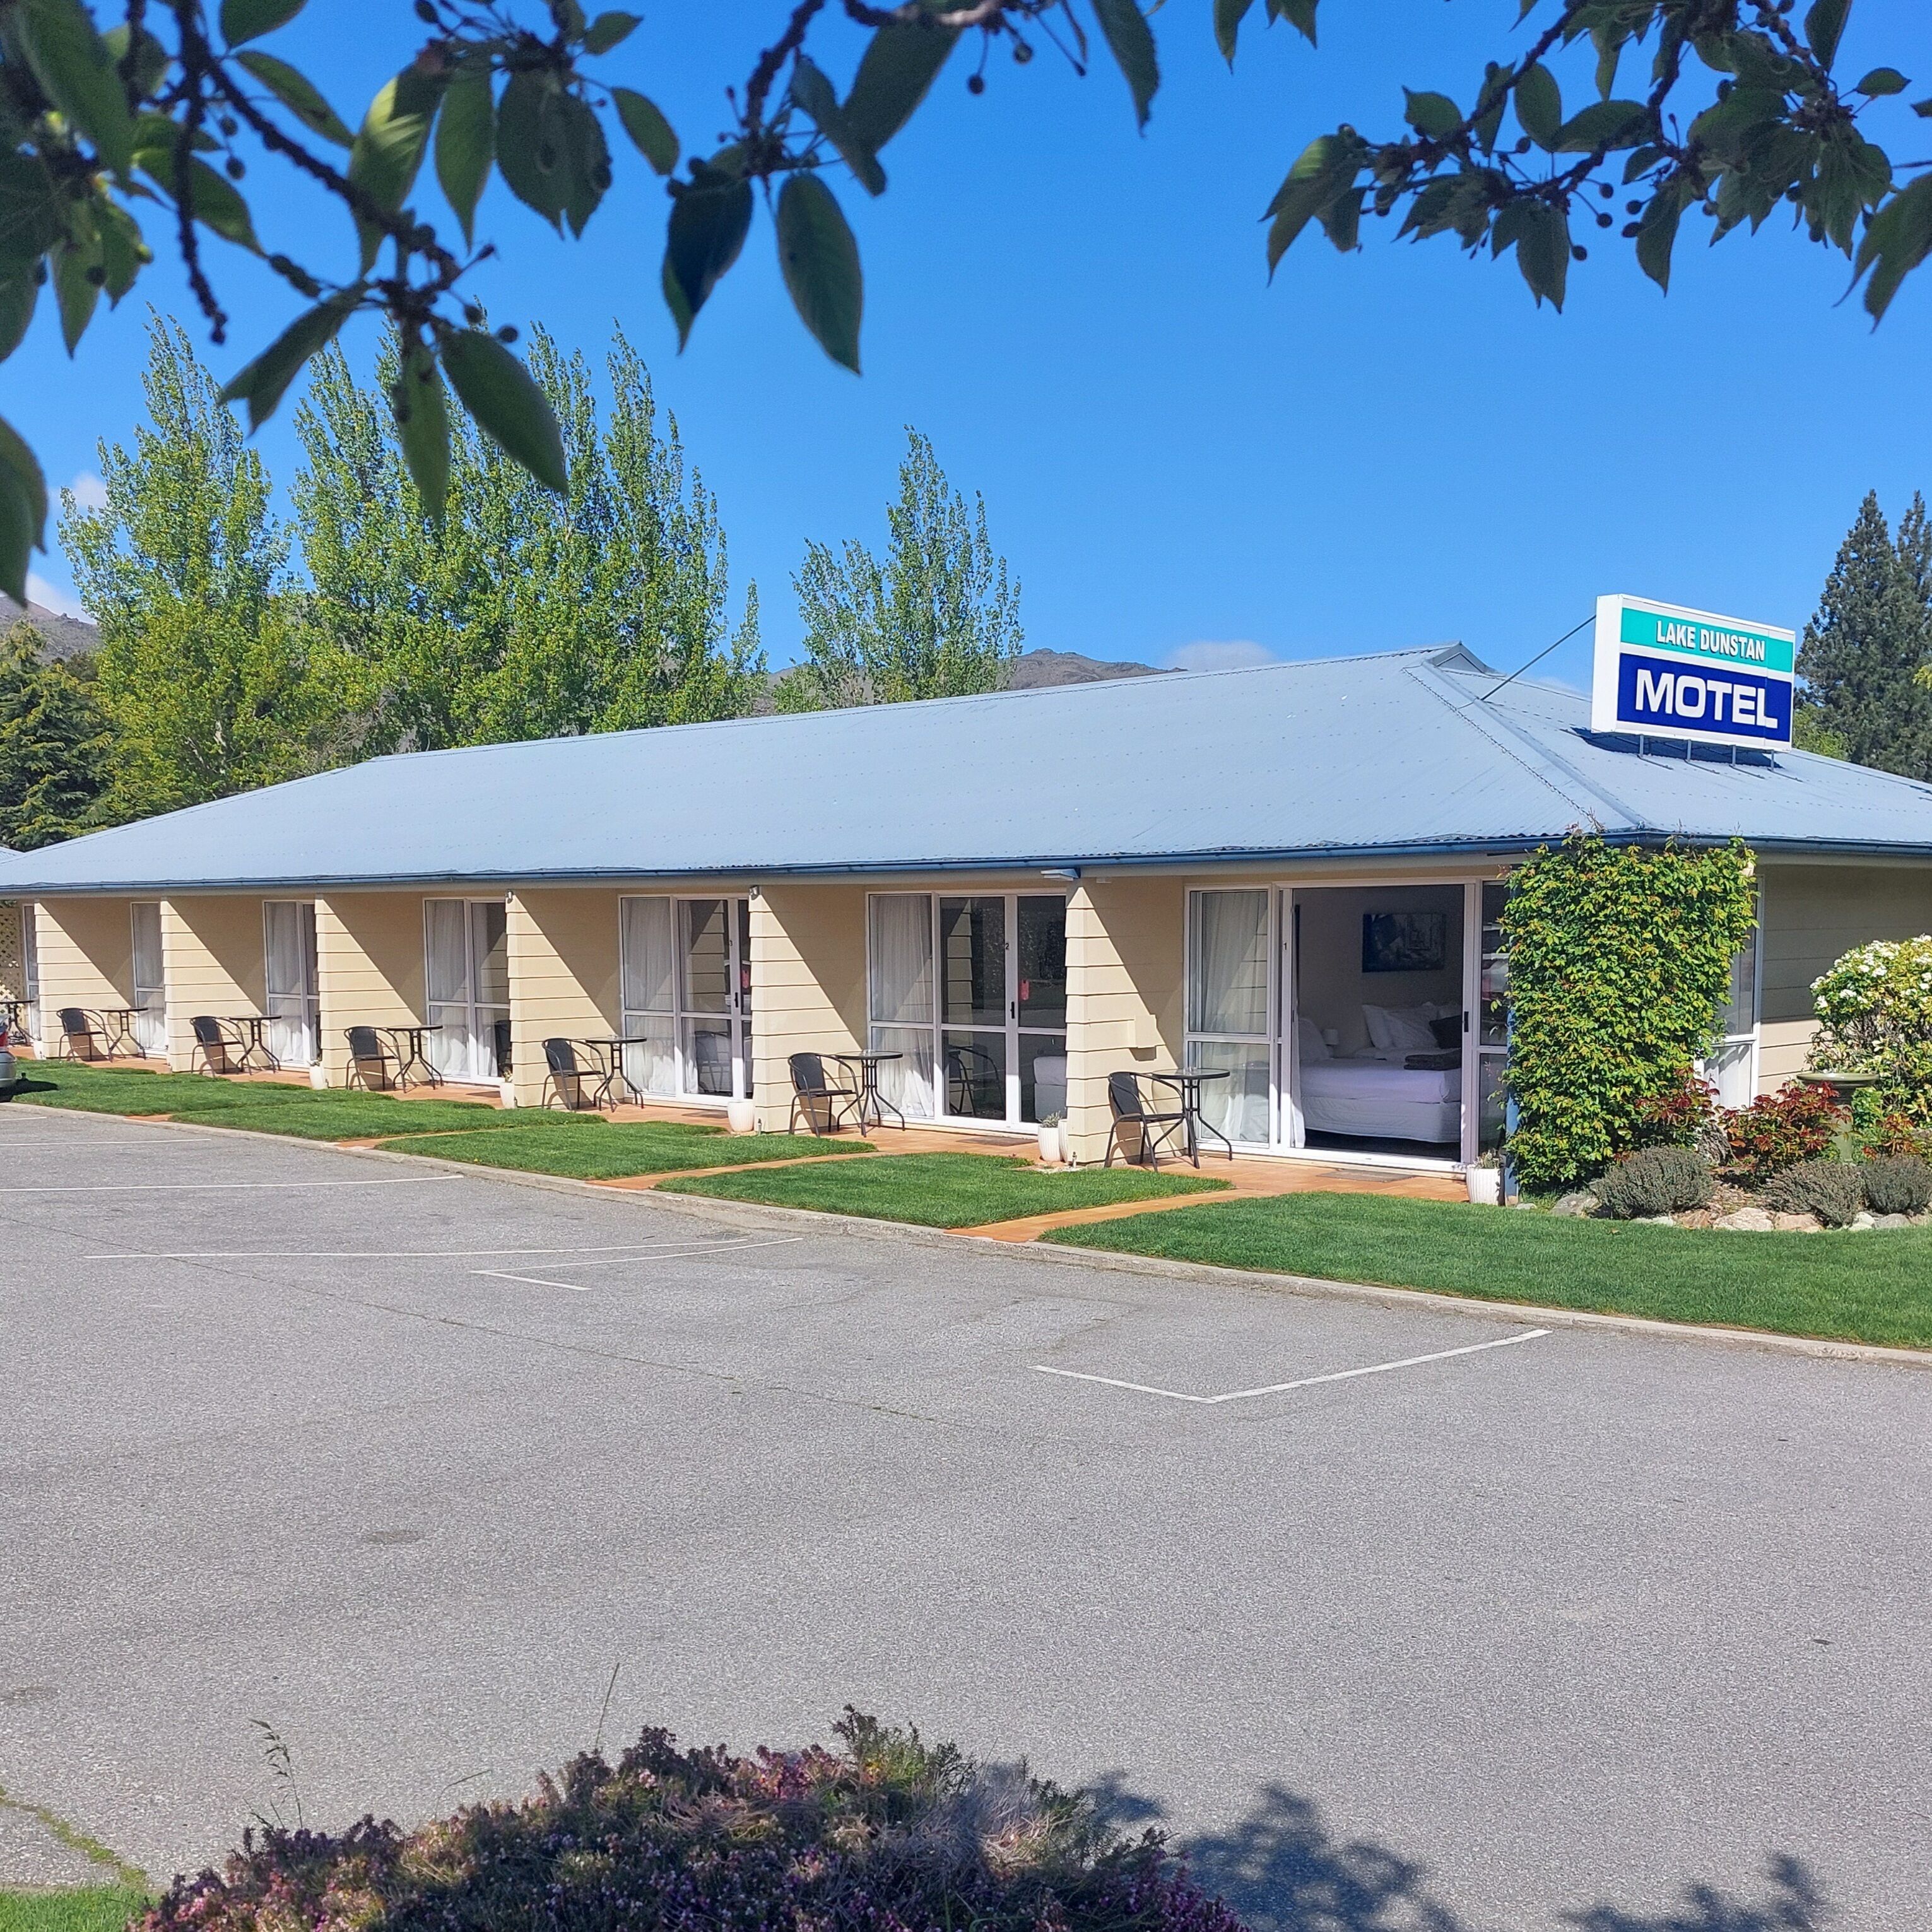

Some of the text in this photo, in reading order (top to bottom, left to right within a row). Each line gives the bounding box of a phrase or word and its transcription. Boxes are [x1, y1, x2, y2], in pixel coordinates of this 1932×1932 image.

[1656, 620, 1765, 661] LAKE DUNSTAN
[1635, 669, 1778, 729] MOTEL
[1283, 942, 1287, 950] 1
